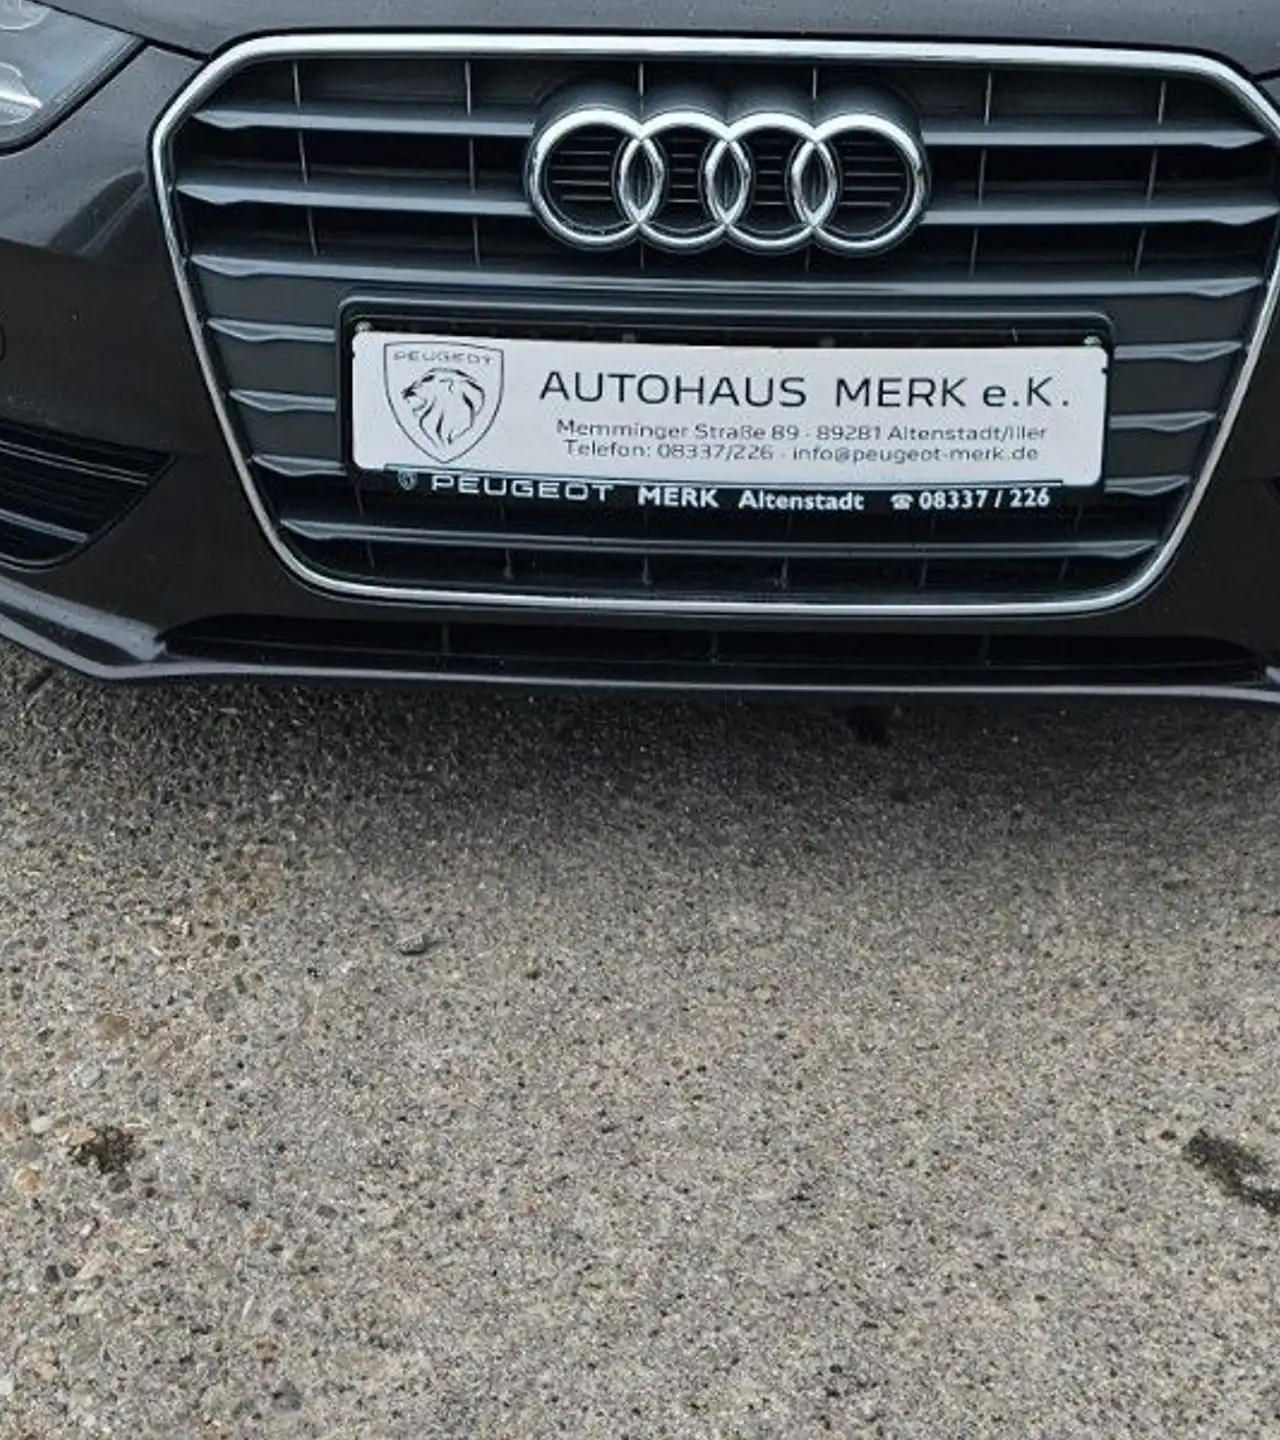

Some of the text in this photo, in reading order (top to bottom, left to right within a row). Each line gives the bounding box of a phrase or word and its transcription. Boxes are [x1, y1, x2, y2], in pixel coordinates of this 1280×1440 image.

[539, 370, 1071, 408] AUTOHAUS MERK e.K.
[556, 418, 687, 440] Memminger
[771, 424, 800, 441] 89
[816, 424, 881, 442] 89281
[563, 438, 651, 459] Telefon:
[656, 443, 773, 462] 08337/226
[431, 474, 613, 502] PEUGEOT
[637, 486, 720, 509] MERK
[738, 489, 865, 511] Altenstadt
[919, 490, 988, 510] 08337
[1010, 486, 1051, 509] 226
